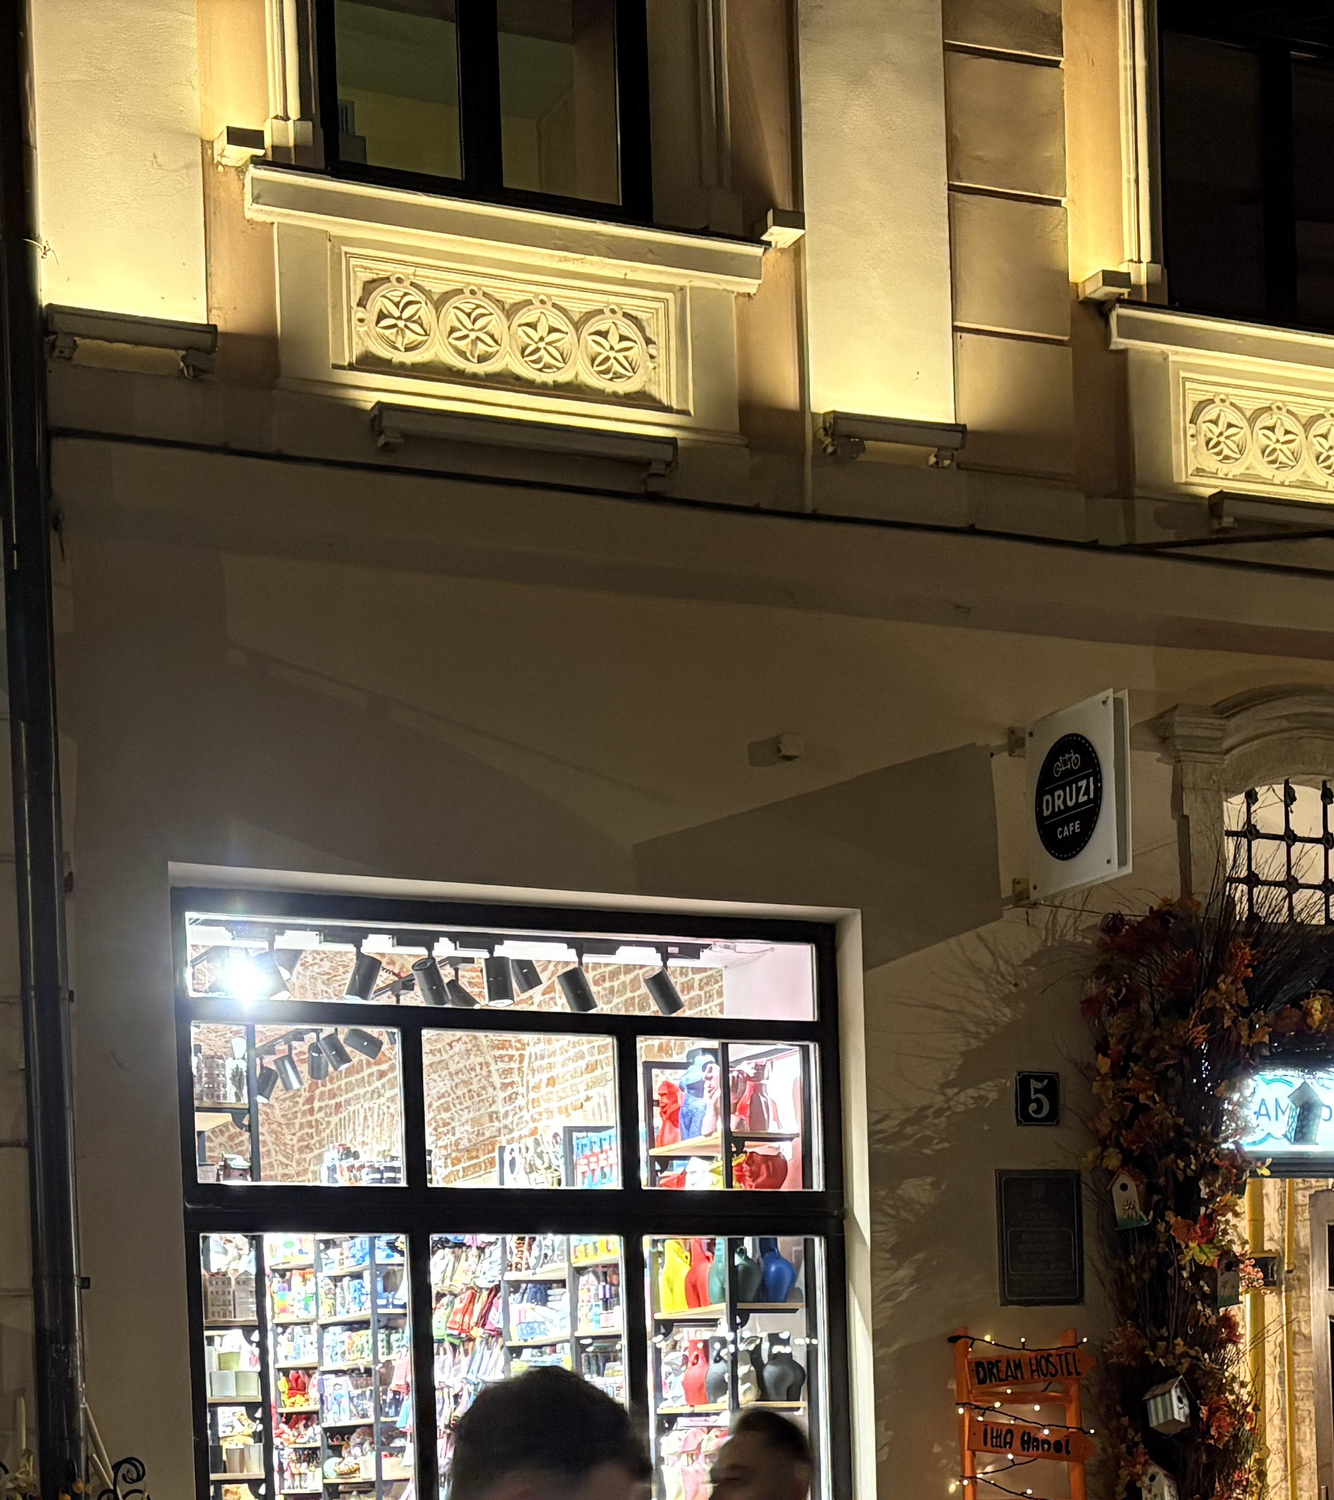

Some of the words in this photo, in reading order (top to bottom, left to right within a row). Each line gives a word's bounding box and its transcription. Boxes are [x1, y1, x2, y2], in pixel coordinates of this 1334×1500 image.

[1042, 776, 1094, 817] DRUZI
[1057, 820, 1081, 839] CAFE
[1028, 1078, 1050, 1119] 5
[1254, 1097, 1291, 1121] AM
[974, 1360, 1024, 1385] DREAM
[1029, 1352, 1081, 1379] HOSTEL
